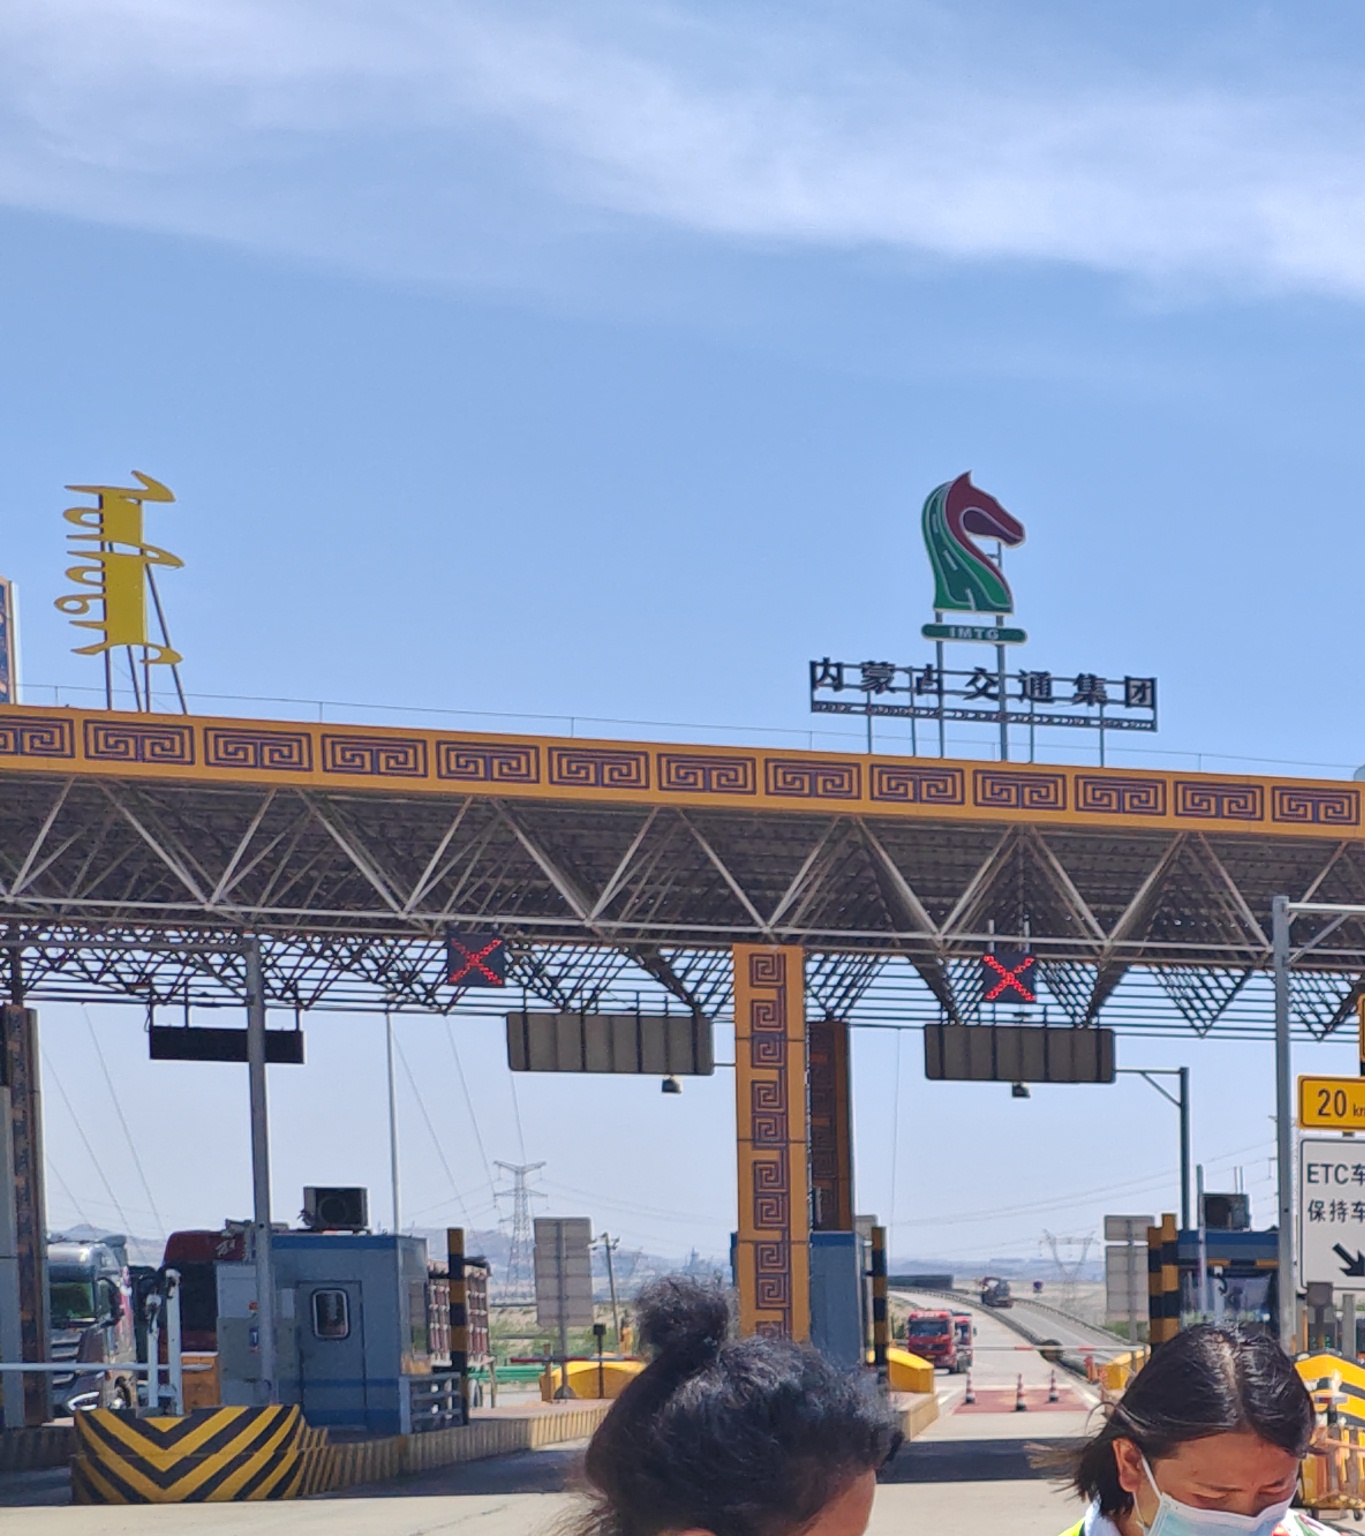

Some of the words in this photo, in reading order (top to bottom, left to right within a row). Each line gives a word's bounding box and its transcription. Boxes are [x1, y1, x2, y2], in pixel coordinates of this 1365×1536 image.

[949, 627, 1000, 641] IMTG
[810, 657, 1157, 709] 内蒙古交通集团
[1317, 1089, 1347, 1118] 20
